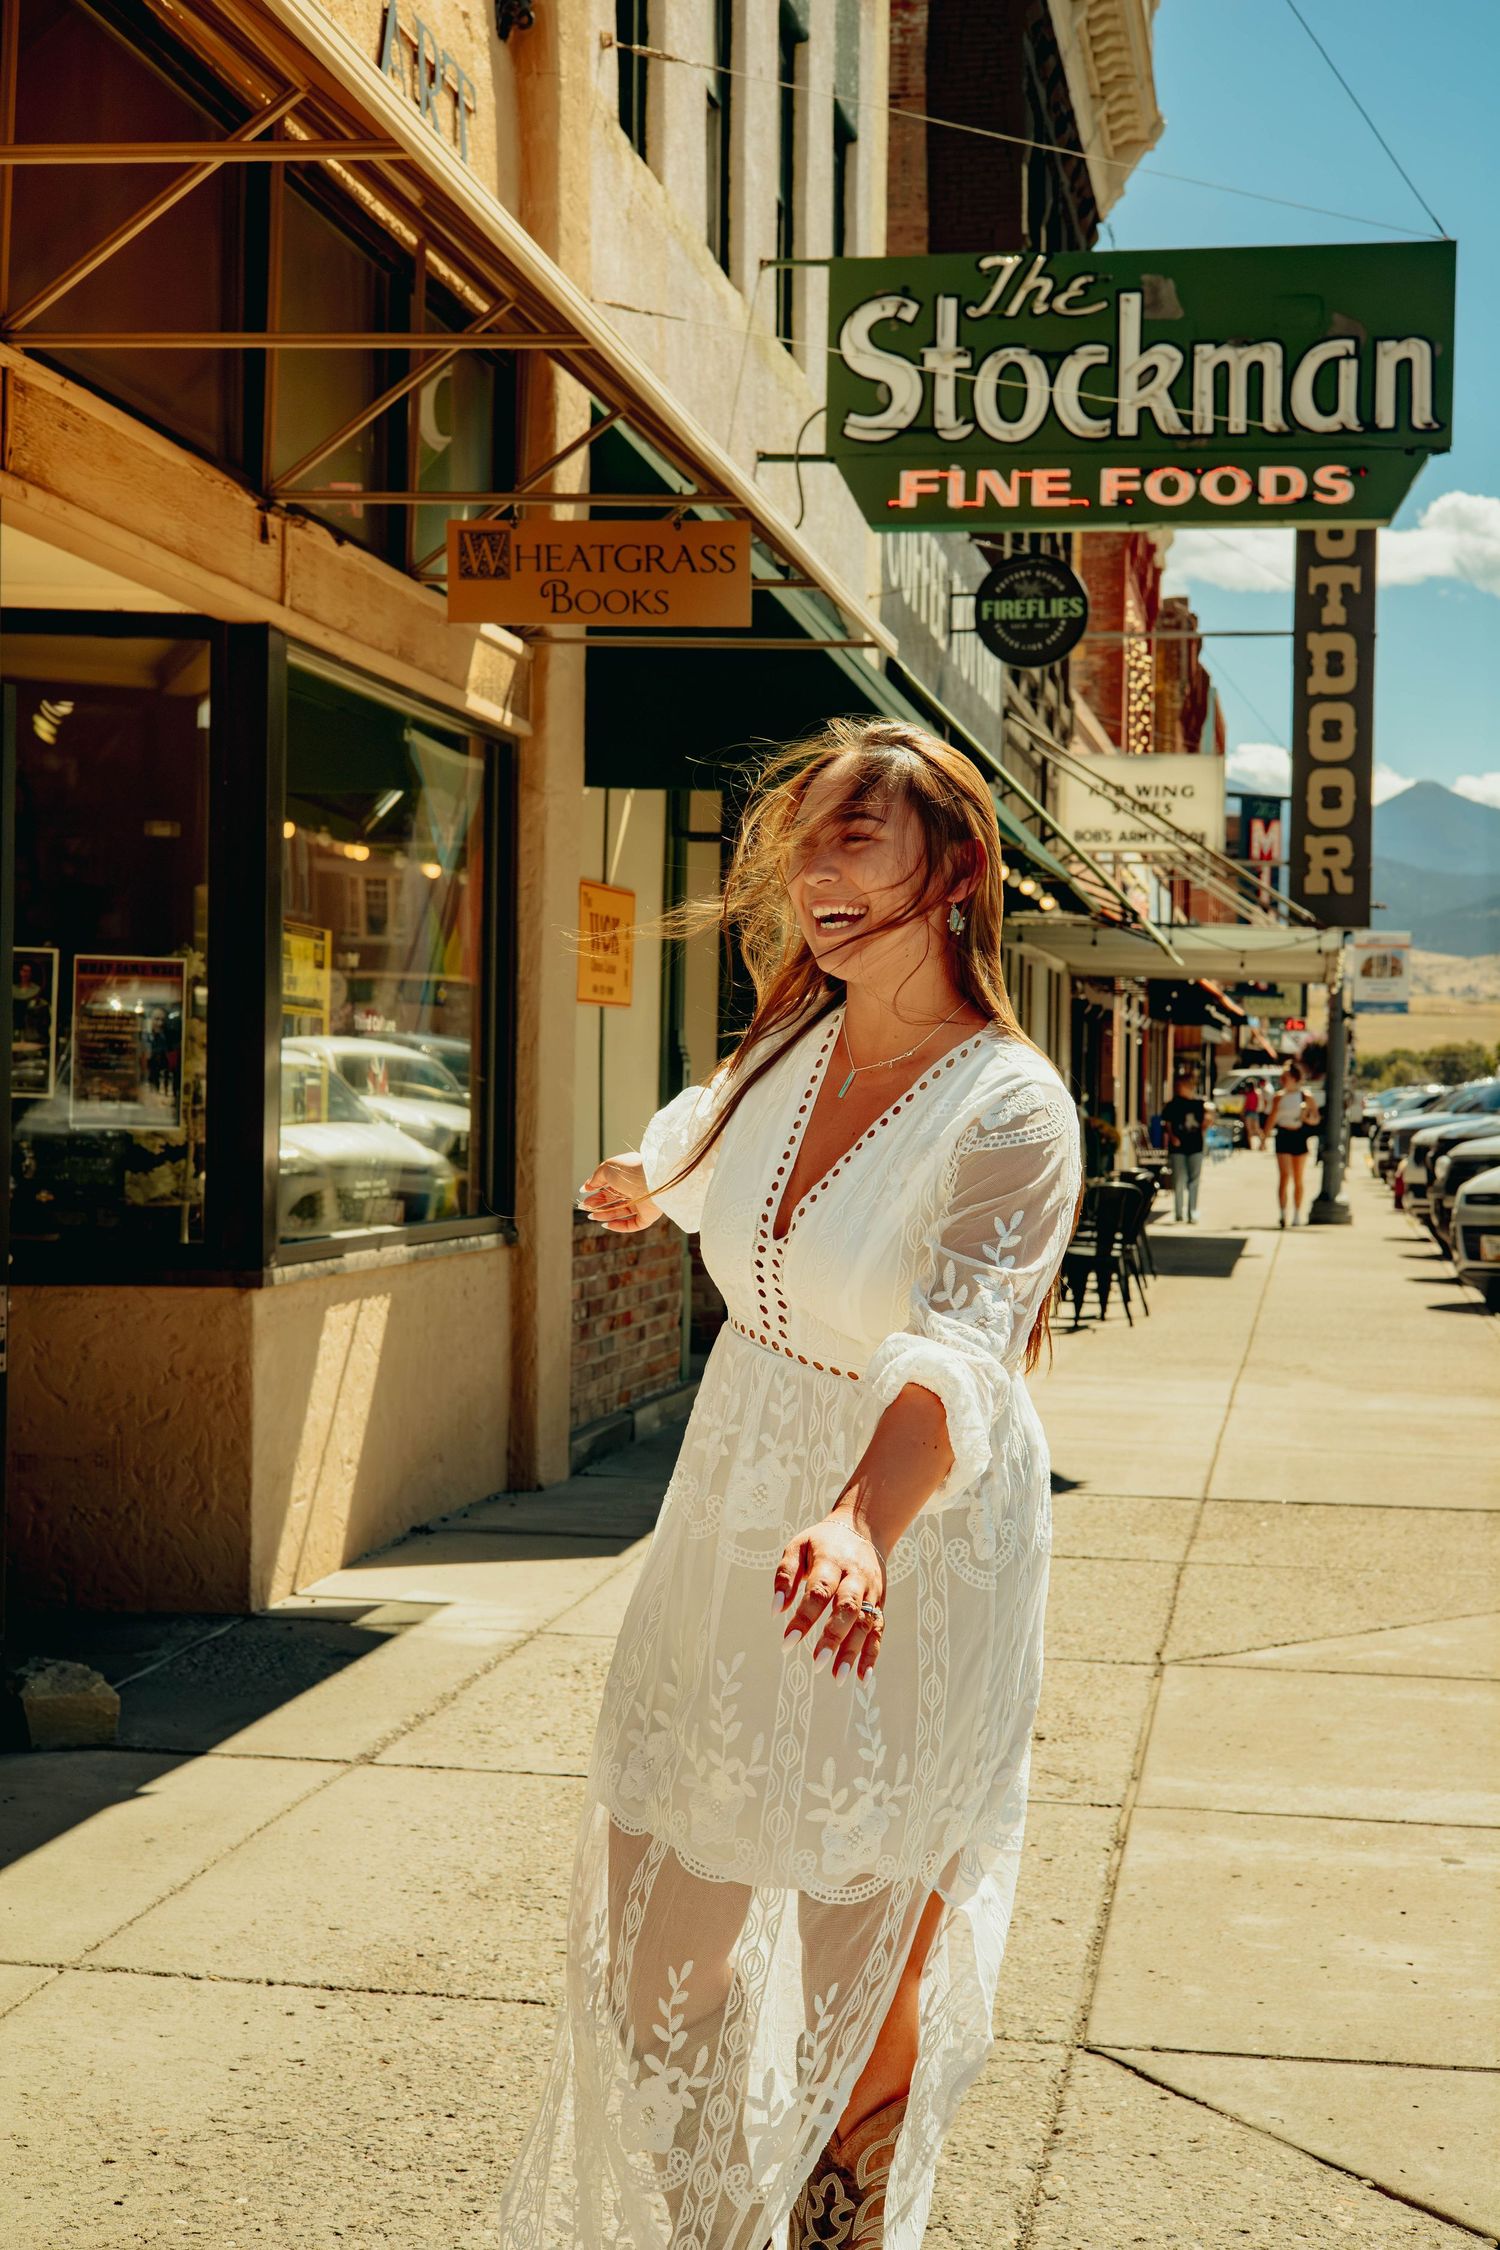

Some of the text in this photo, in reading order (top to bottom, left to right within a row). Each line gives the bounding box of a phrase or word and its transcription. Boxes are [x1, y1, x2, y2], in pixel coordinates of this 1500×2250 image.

[966, 255, 1110, 318] The
[840, 291, 1442, 443] Stockman
[898, 465, 1357, 508] FINE FOODS
[457, 529, 737, 580] WHEATGRASS
[540, 579, 670, 615] BOOKS
[981, 596, 1085, 621] FIREFLIES
[1135, 783, 1196, 799] WING
[1073, 829, 1112, 844] BOB'S
[1118, 830, 1158, 844] ARMY
